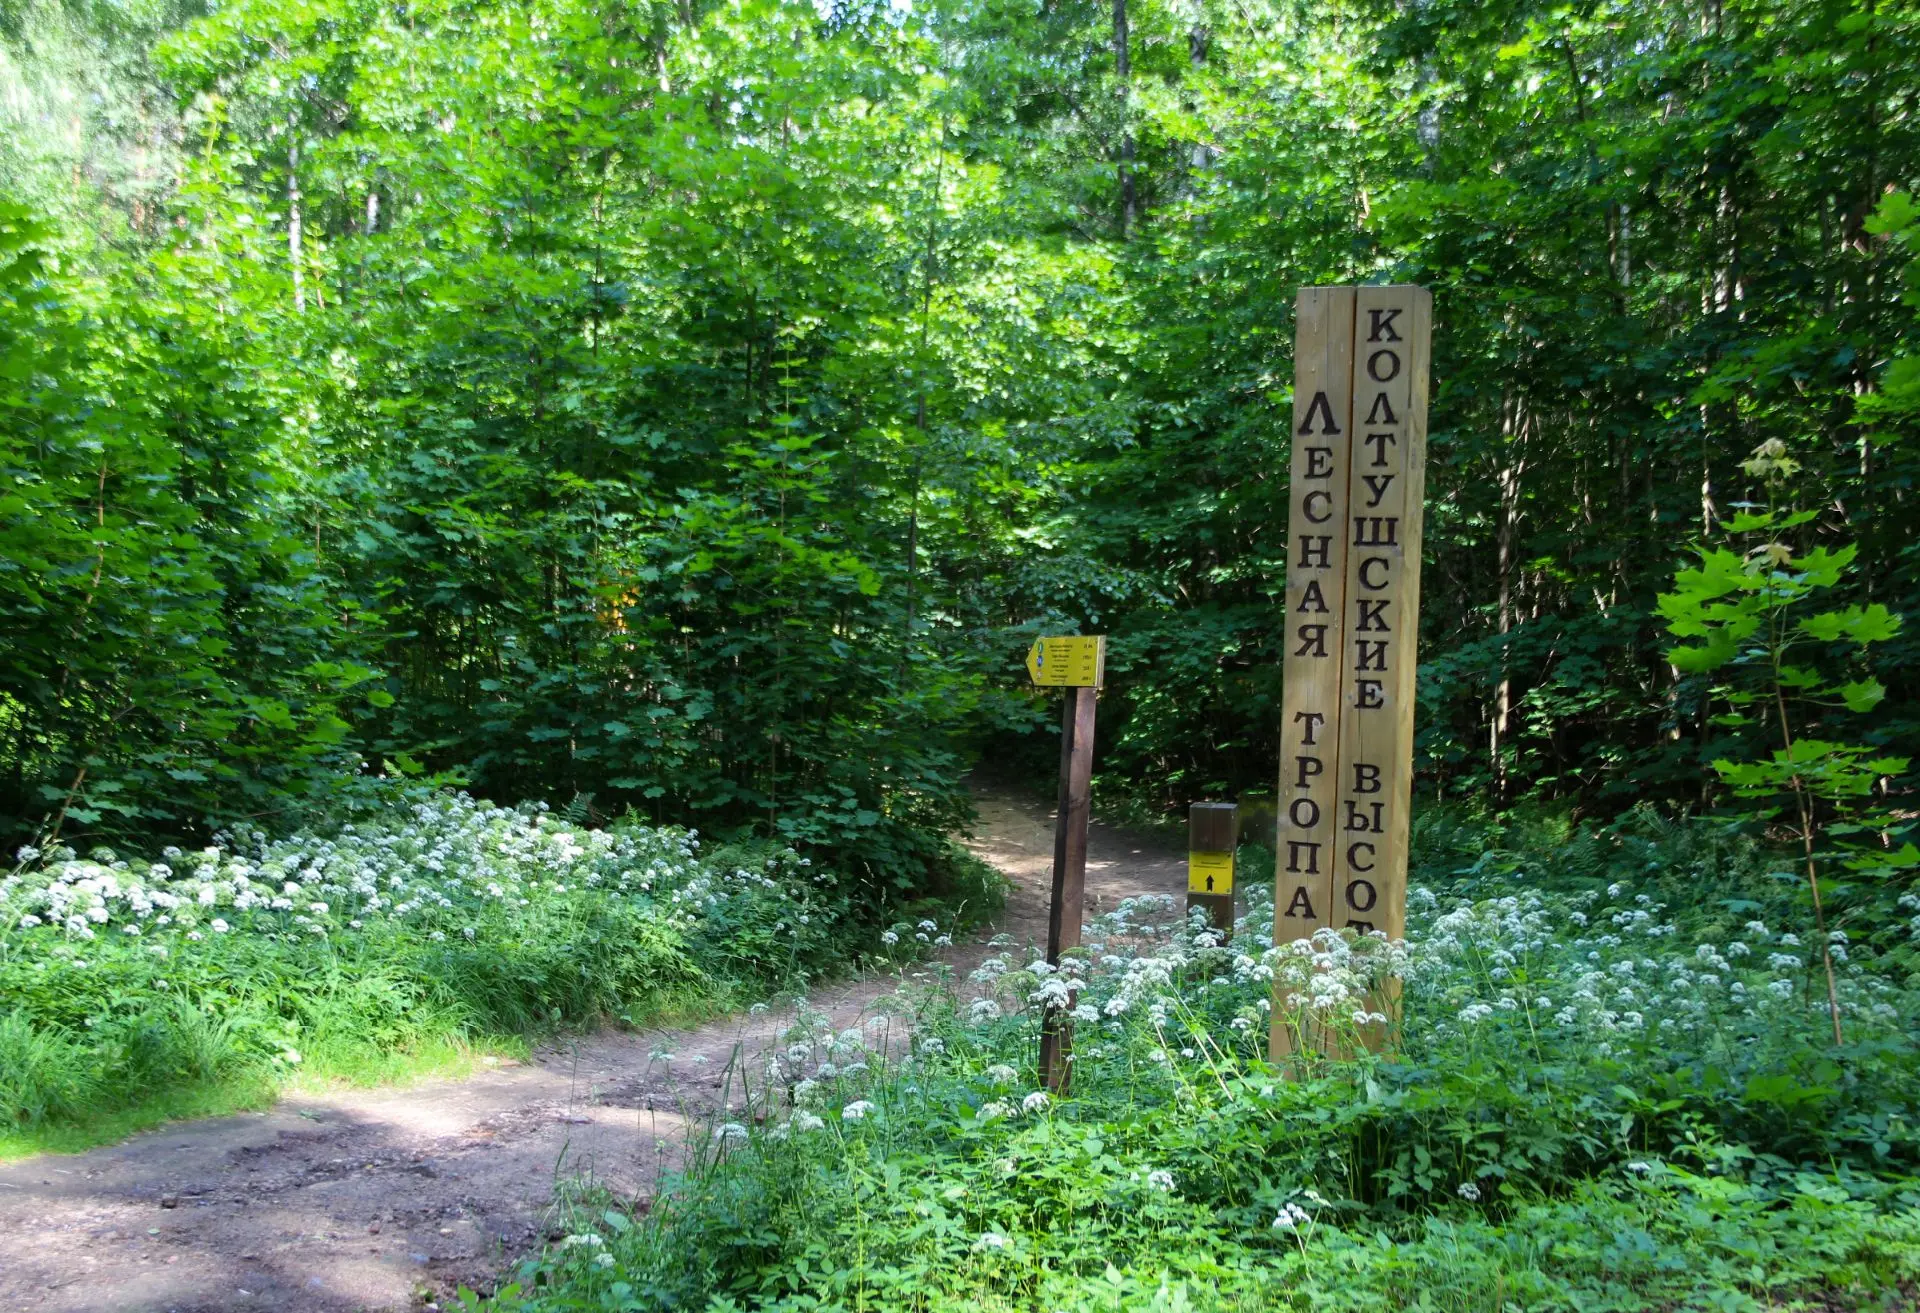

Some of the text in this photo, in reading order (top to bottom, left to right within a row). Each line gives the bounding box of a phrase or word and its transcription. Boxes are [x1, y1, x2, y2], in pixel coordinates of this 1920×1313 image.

[1285, 391, 1341, 919] ЛЕСНАЯ ТРОПА
[1353, 309, 1403, 710] КОЛТУШСКИЕ
